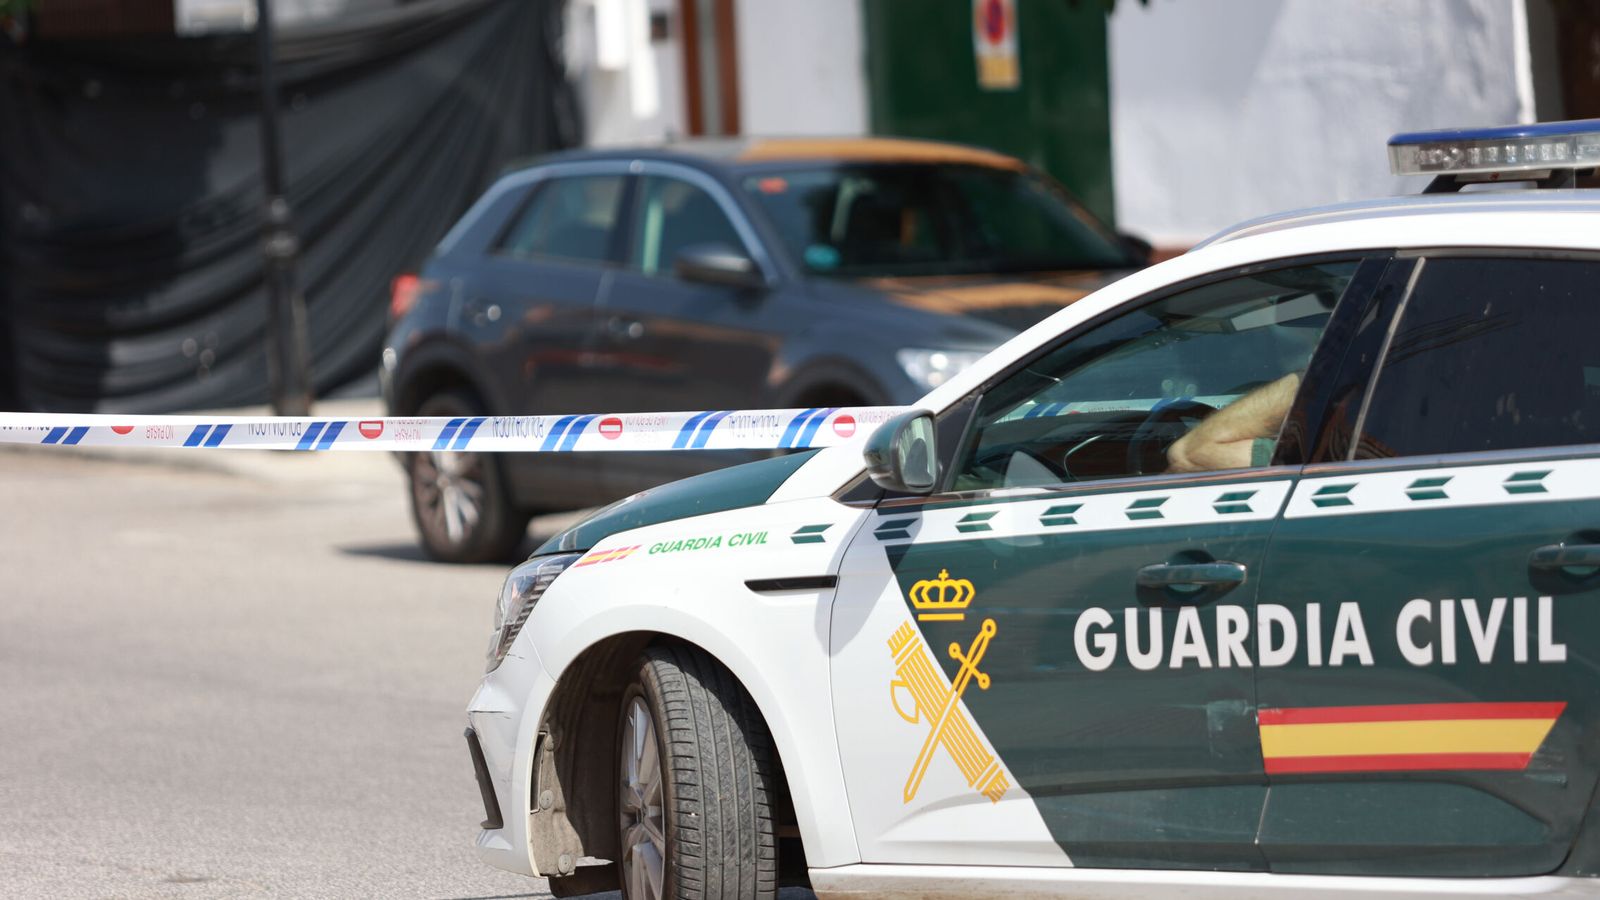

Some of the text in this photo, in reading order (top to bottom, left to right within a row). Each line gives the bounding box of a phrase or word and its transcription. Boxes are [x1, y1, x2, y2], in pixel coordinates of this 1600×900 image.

[648, 531, 769, 555] GUARDIA CIVIL
[1073, 596, 1568, 672] GUARDIA CIVIL
